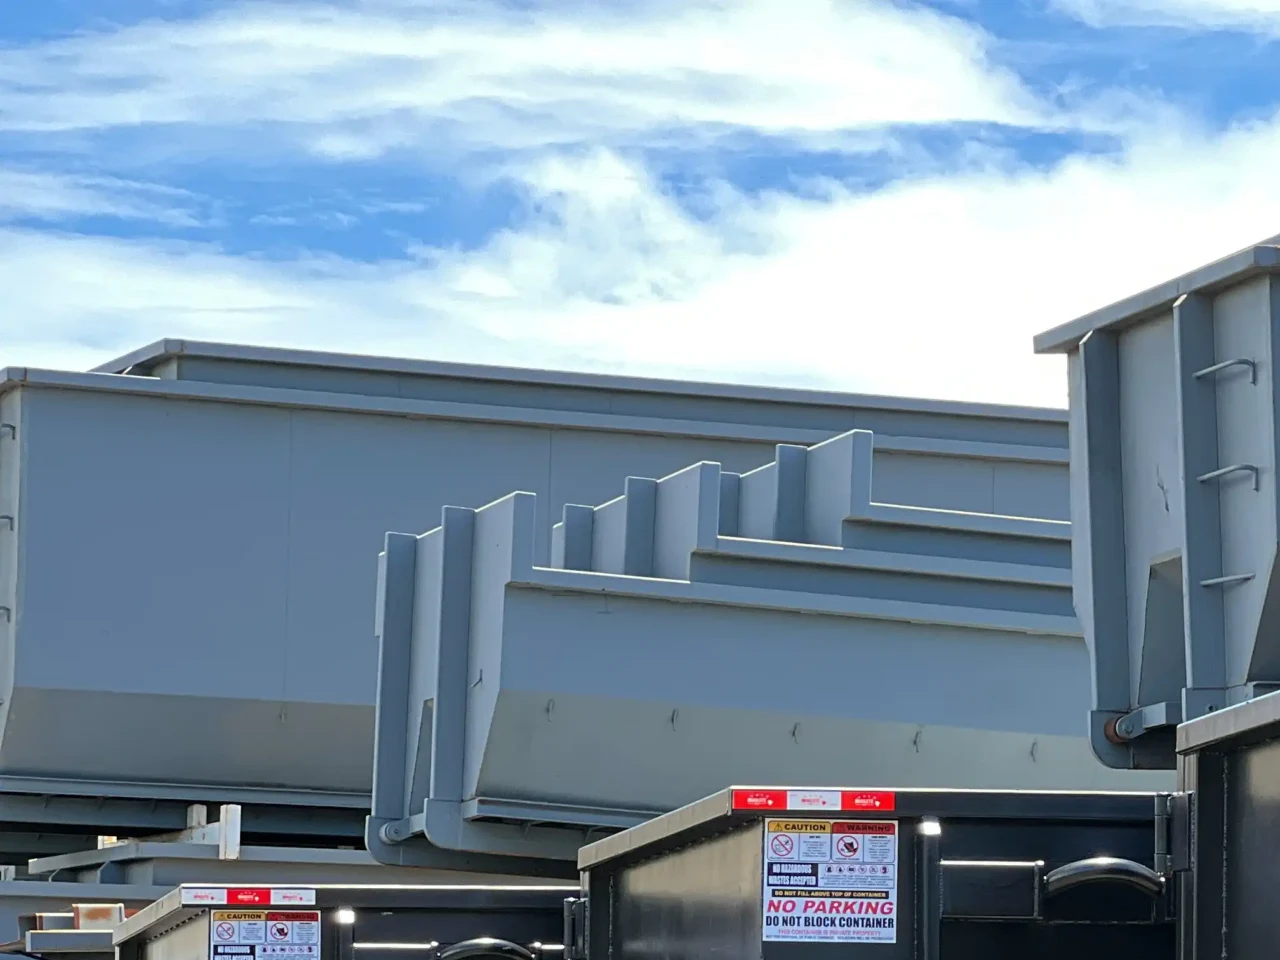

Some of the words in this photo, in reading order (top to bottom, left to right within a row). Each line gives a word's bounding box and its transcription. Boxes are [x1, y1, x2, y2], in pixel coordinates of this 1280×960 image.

[767, 900, 796, 913] NO
[803, 900, 894, 915] PARKING
[766, 916, 779, 926] DO
[782, 916, 801, 927] NOT
[804, 916, 836, 927] BLOCK
[839, 917, 894, 928] CONTAINER
